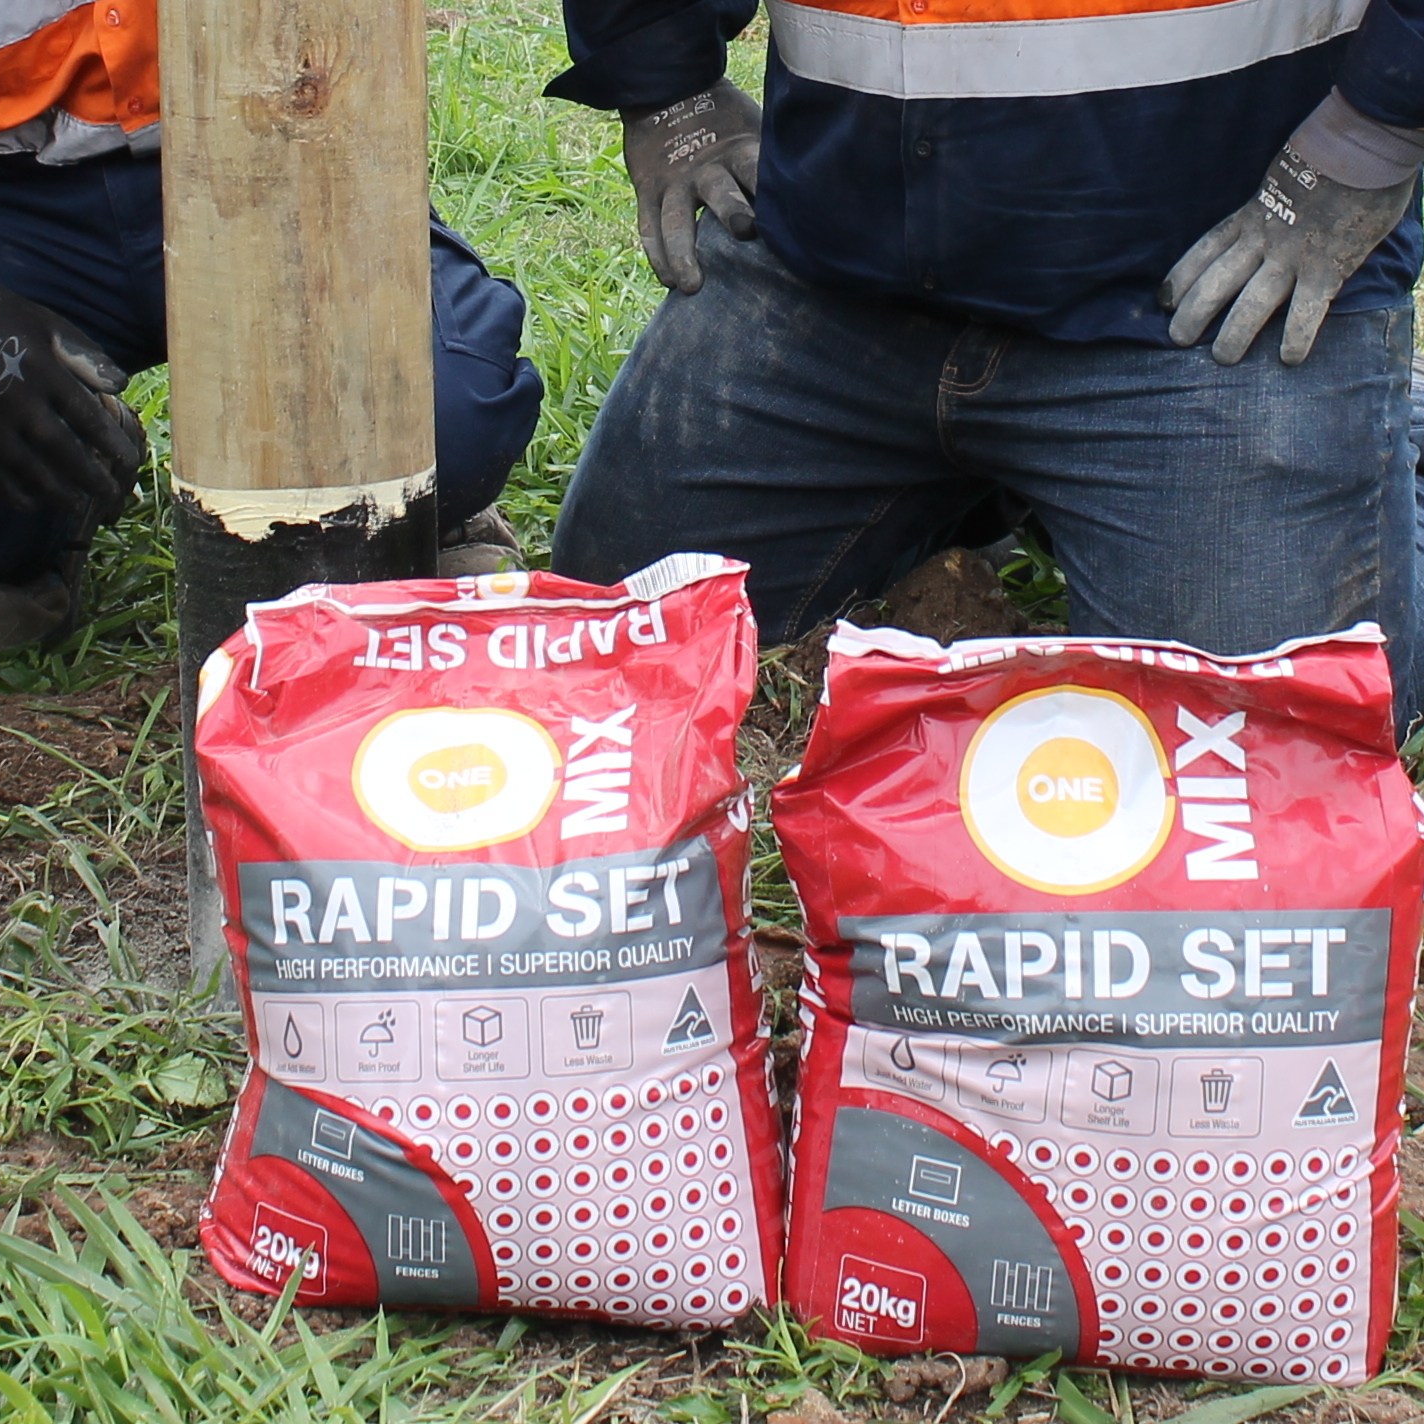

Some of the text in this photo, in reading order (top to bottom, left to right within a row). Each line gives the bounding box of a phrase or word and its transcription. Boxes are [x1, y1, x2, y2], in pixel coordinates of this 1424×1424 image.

[667, 132, 716, 165] uvex
[1258, 189, 1296, 225] uvex
[352, 601, 669, 671] RAPID SET
[418, 765, 492, 790] ONE
[560, 702, 637, 841] MIX
[1027, 773, 1103, 804] ONE
[1175, 704, 1259, 882] MIX
[270, 859, 691, 945] RAPID SET
[275, 957, 314, 980] HIGH
[321, 956, 480, 980] PERFORMANCE
[499, 950, 612, 975] SUPERIOR
[618, 938, 694, 969] QUALITY
[880, 927, 1346, 1000] RAPID SET
[893, 1005, 941, 1028] HIGH
[947, 1011, 1114, 1035] PERFORMANCE
[1134, 1011, 1244, 1035] SUPERIOR
[1250, 1010, 1340, 1034] QUALITY
[468, 1051, 499, 1062] Longer
[564, 1054, 613, 1067] Less Waste
[663, 1041, 699, 1055] AUSTRALIAN
[358, 1061, 400, 1072] Rain Proof
[463, 1061, 505, 1073] Shelf Life
[908, 1078, 933, 1091] Water
[981, 1094, 1025, 1111] Rain Proof
[1093, 1103, 1124, 1116] Longer
[1087, 1115, 1129, 1127] Shelf Life
[1190, 1118, 1240, 1129] Less Waste
[1294, 1118, 1336, 1127] AUSTRALIAN
[297, 1149, 365, 1183] LETTER BOXES
[892, 1197, 970, 1228] LETTER BOXES
[254, 1225, 321, 1280] 20kg
[252, 1257, 284, 1282] NET
[395, 1266, 439, 1279] FENCES
[842, 1277, 917, 1327] 20kg
[842, 1309, 877, 1333] NET
[997, 1313, 1041, 1328] FENCES
